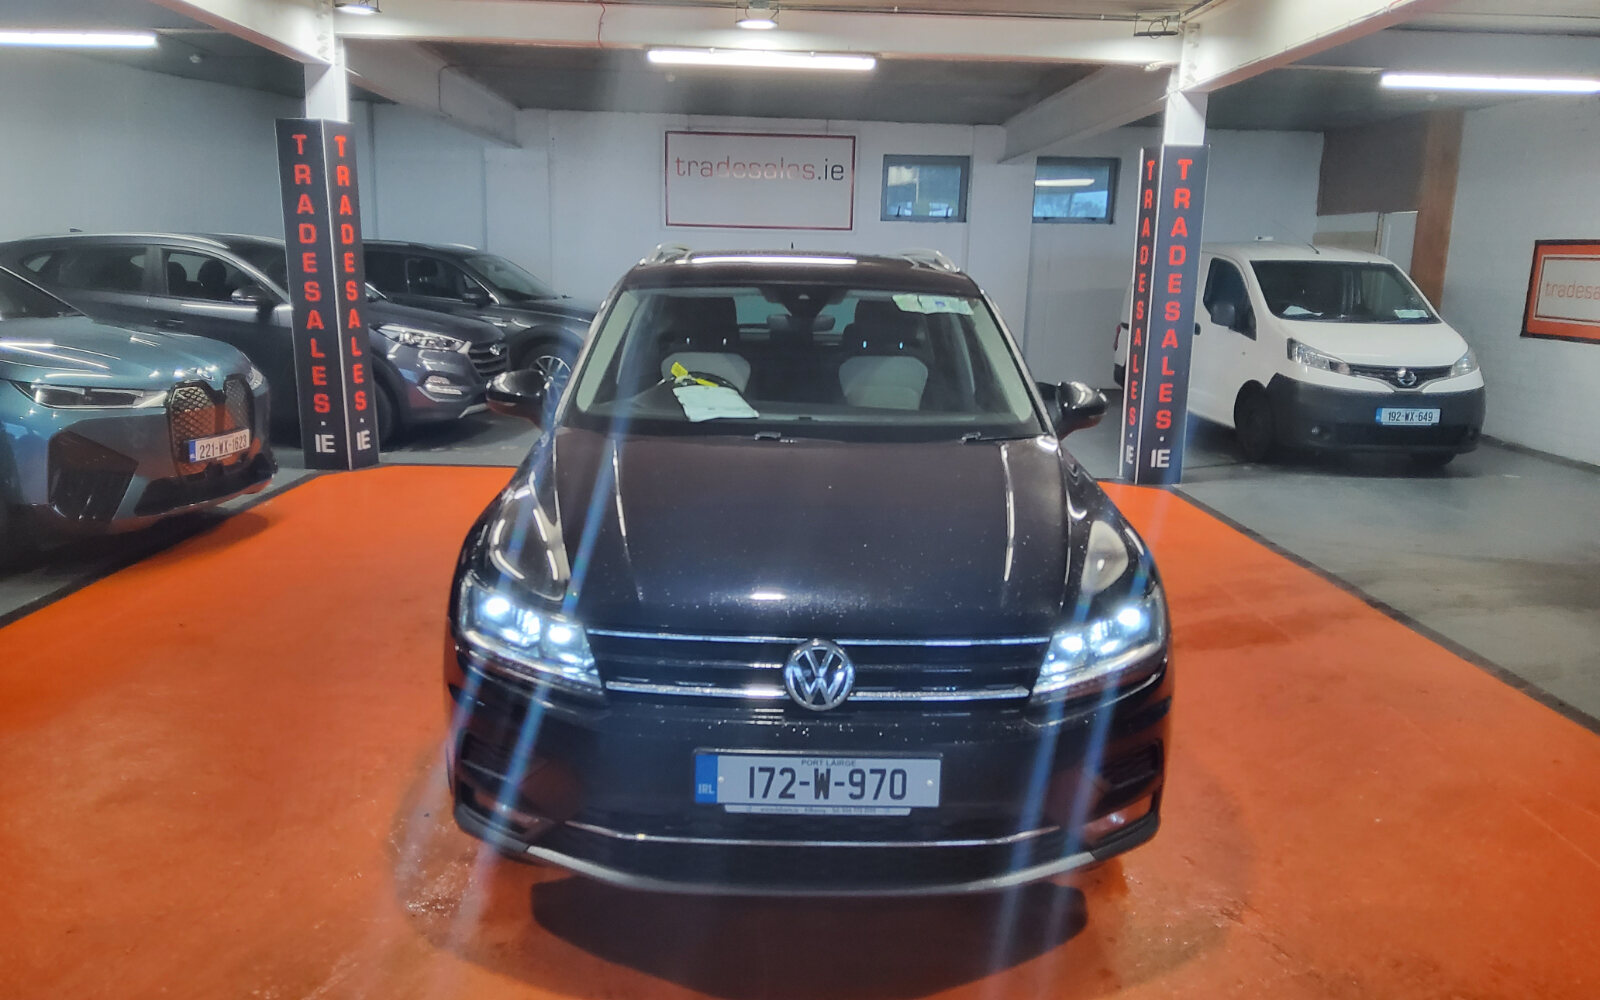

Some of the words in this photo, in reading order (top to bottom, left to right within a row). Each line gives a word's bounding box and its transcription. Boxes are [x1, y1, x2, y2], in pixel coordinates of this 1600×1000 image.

[675, 156, 844, 180] tradesales.ie
[1388, 411, 1434, 422] 192-WX-649
[200, 433, 247, 458] 221-WX-1623
[801, 759, 823, 767] PORT
[698, 783, 715, 794] IRL
[749, 766, 907, 800] 172-W-970
